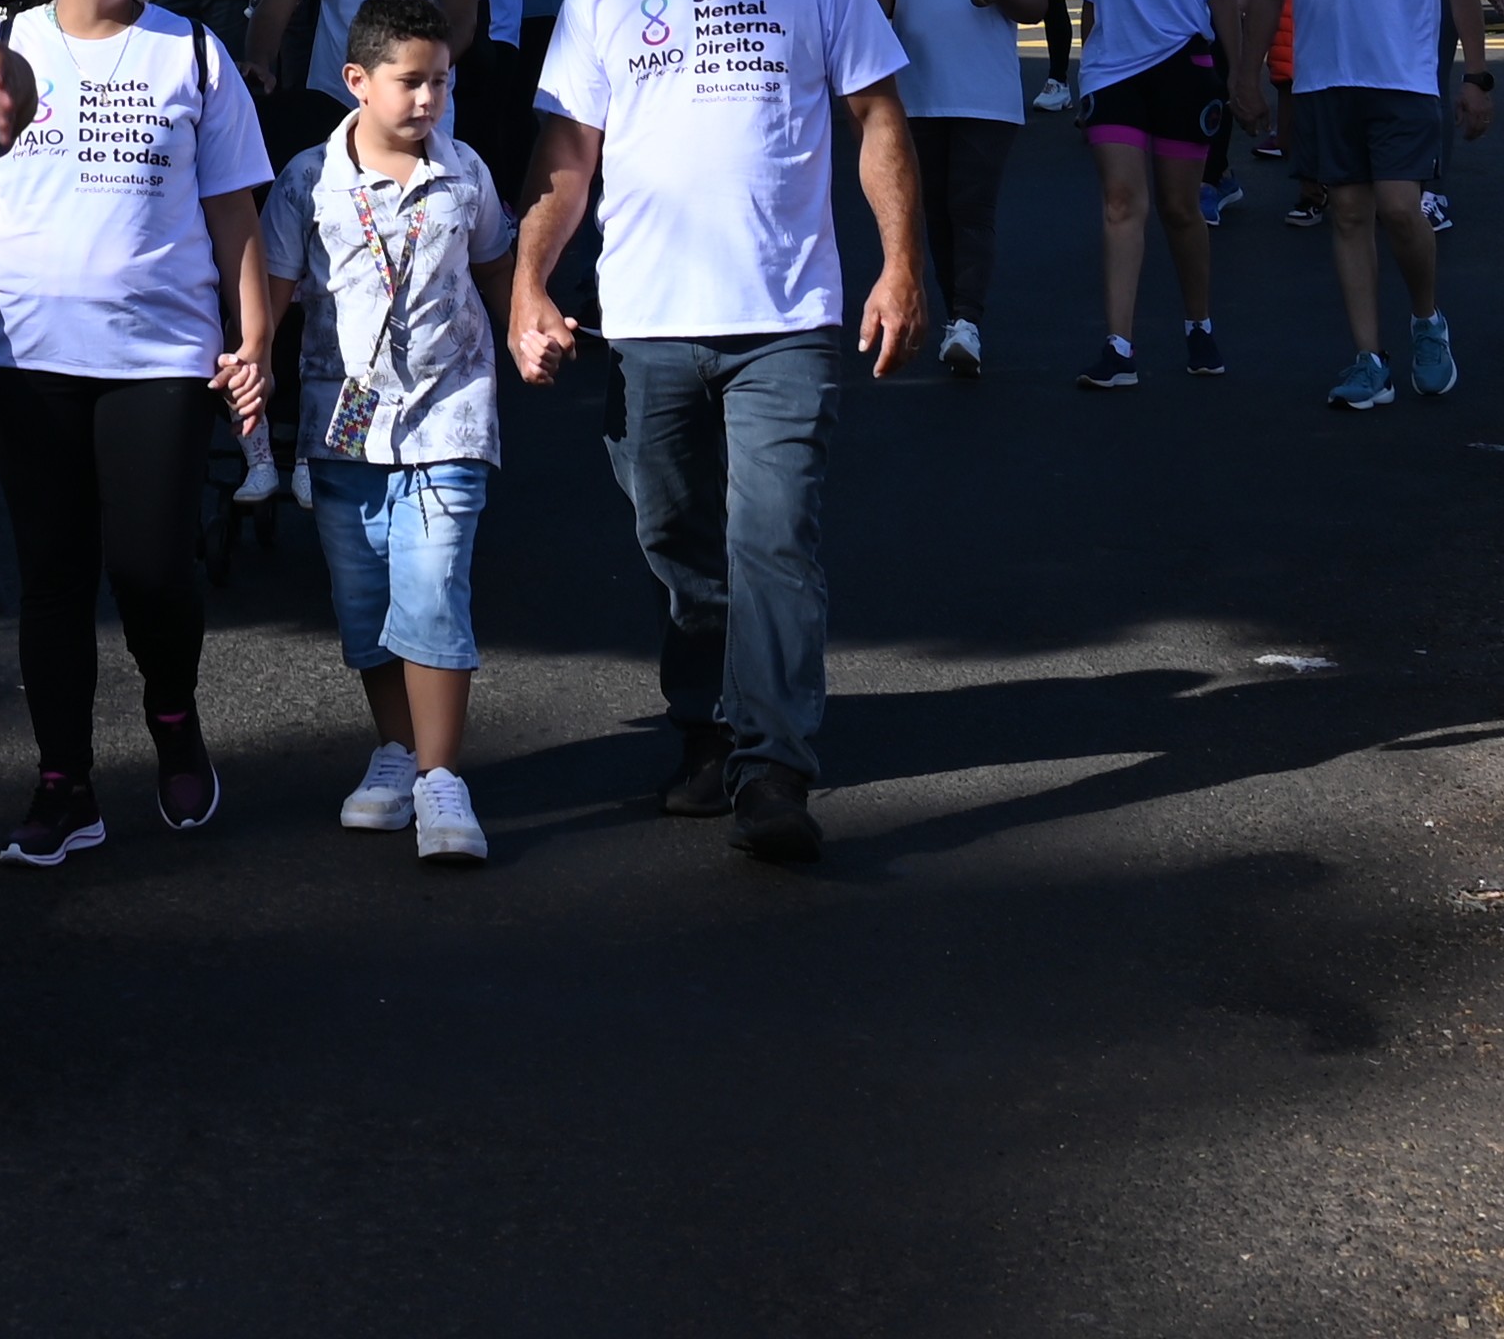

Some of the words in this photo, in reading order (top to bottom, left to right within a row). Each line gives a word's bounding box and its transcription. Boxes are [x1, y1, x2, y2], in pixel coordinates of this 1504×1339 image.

[694, 0, 767, 22] Mental
[695, 21, 786, 40] Materna,
[695, 38, 765, 57] Direito
[628, 49, 684, 73] MAIO
[694, 59, 721, 75] de
[726, 56, 789, 74] todas.
[79, 79, 150, 93] Saúde
[696, 81, 781, 94] Botucatu-SP
[79, 95, 157, 108] Mental
[79, 111, 174, 131] Materna,
[78, 128, 155, 144] Direito
[78, 147, 107, 163] de
[113, 147, 172, 168] todas.
[80, 172, 164, 187] Botucatu-SP
